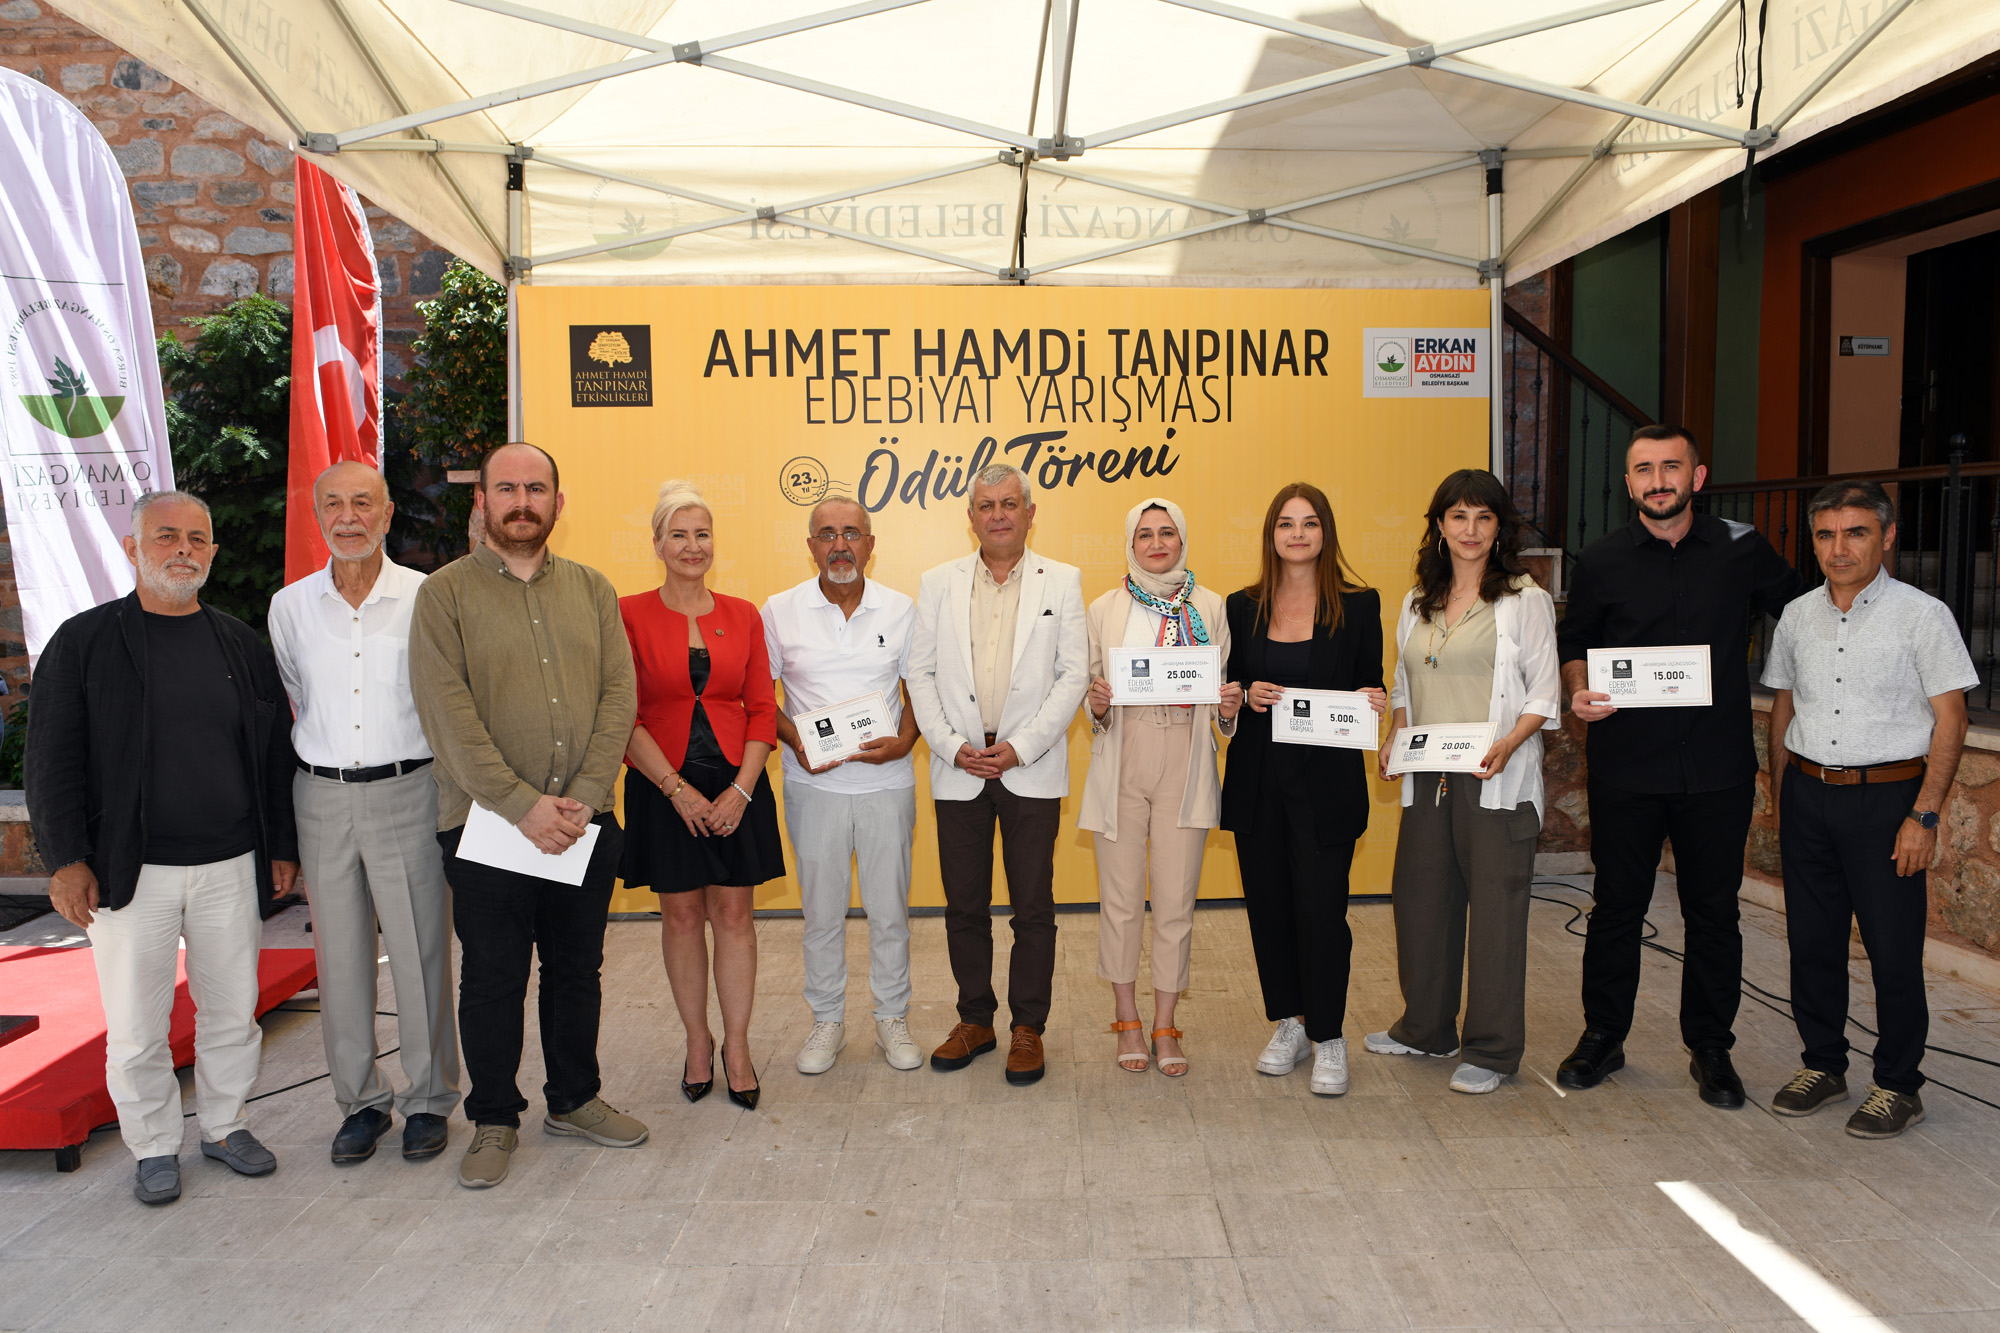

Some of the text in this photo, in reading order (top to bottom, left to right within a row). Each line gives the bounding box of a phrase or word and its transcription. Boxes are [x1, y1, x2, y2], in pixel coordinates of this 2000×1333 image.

[1415, 338, 1475, 353] ERKAN
[703, 329, 890, 379] AHMET
[1108, 329, 1329, 377] TANPINAR
[1416, 355, 1472, 370] AYDIN
[575, 370, 647, 379] AHMET HAMDİ
[575, 380, 647, 391] TANPINAR
[576, 392, 648, 402] ETKİNLİKLERİ
[1016, 375, 1231, 432] YARIŞMASI
[857, 427, 1180, 513] Ödül Töreni
[791, 472, 817, 487] 23.
[1167, 670, 1197, 679] 25.000
[1653, 671, 1685, 680] 15.000
[850, 717, 872, 730] 5.000
[1330, 713, 1353, 723] 5.000
[1441, 742, 1471, 750] 20.000
